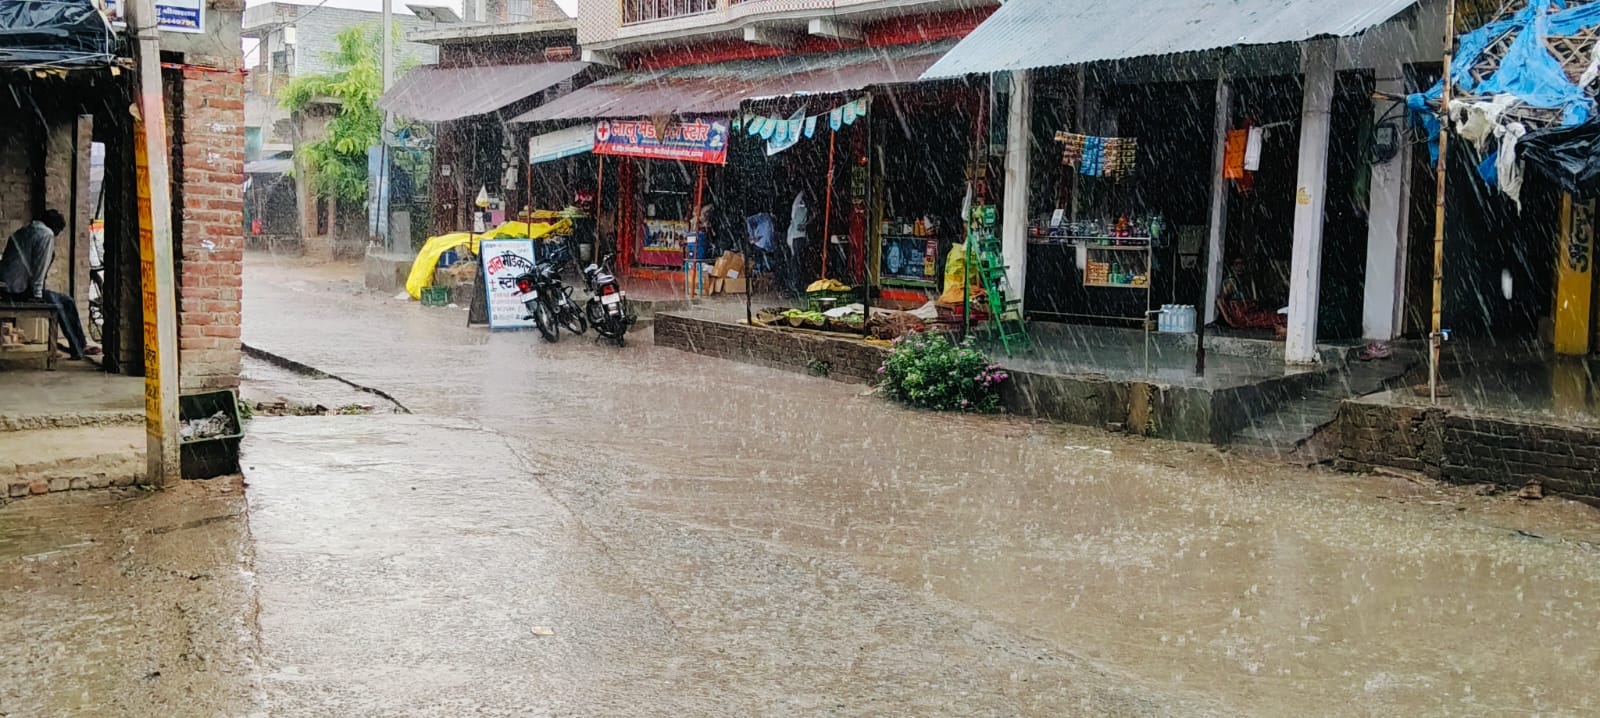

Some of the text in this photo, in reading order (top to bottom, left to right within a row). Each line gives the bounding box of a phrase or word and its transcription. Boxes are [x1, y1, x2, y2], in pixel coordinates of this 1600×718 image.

[611, 120, 638, 143] लालू
[682, 118, 710, 141] स्टोर
[498, 273, 517, 289] स्टो
